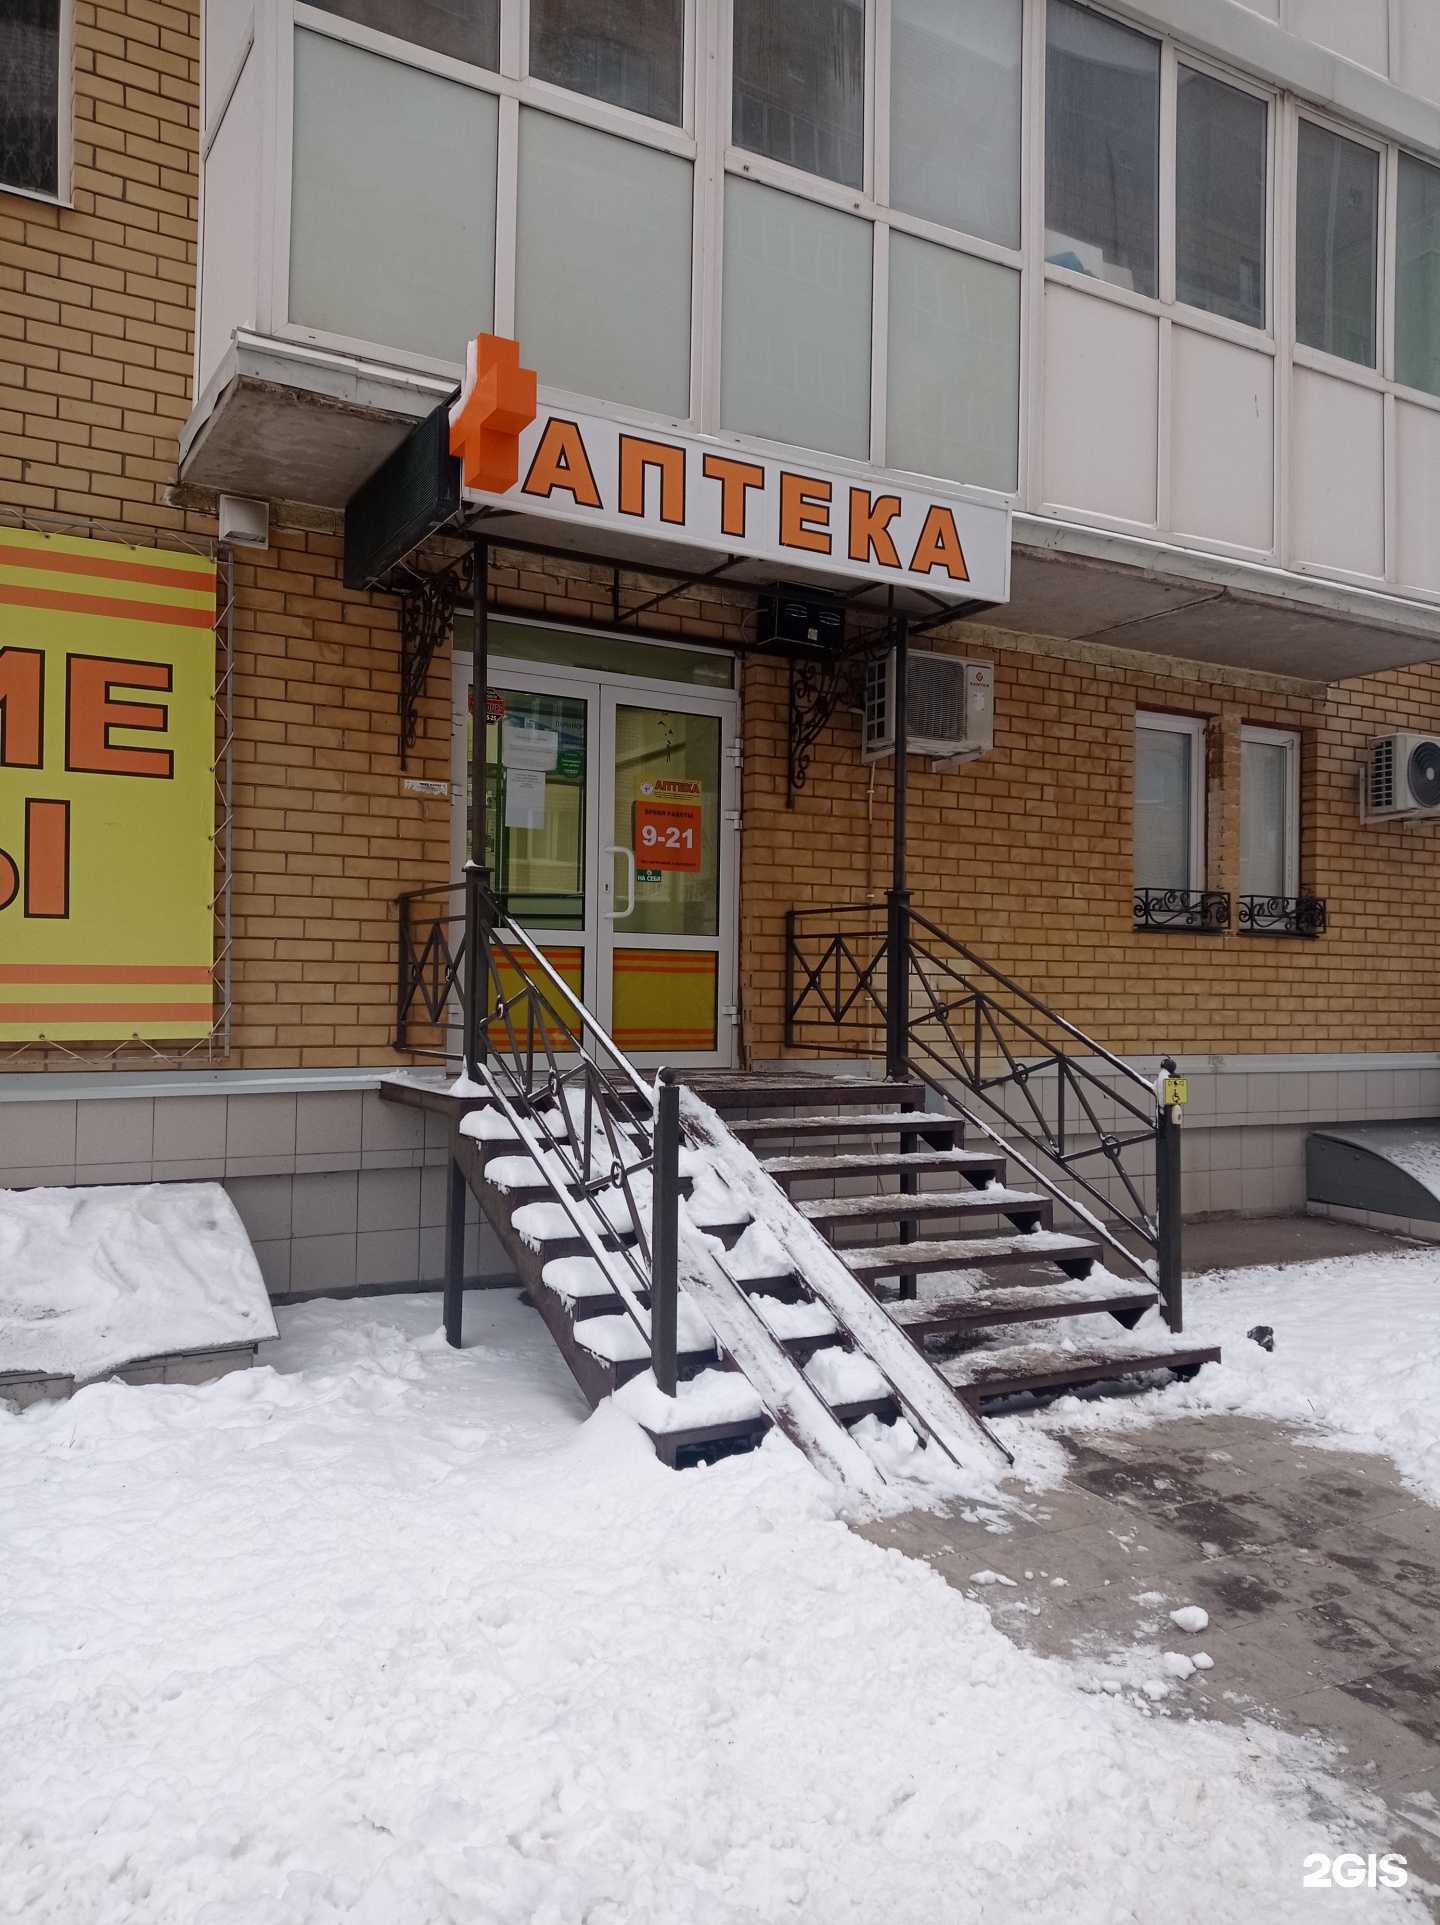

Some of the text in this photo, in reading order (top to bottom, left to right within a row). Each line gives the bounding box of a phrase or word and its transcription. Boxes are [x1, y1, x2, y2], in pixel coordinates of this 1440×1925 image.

[521, 415, 970, 582] АПТЕКА
[655, 779, 701, 793] АПТЕКА
[641, 824, 693, 849] 9-21
